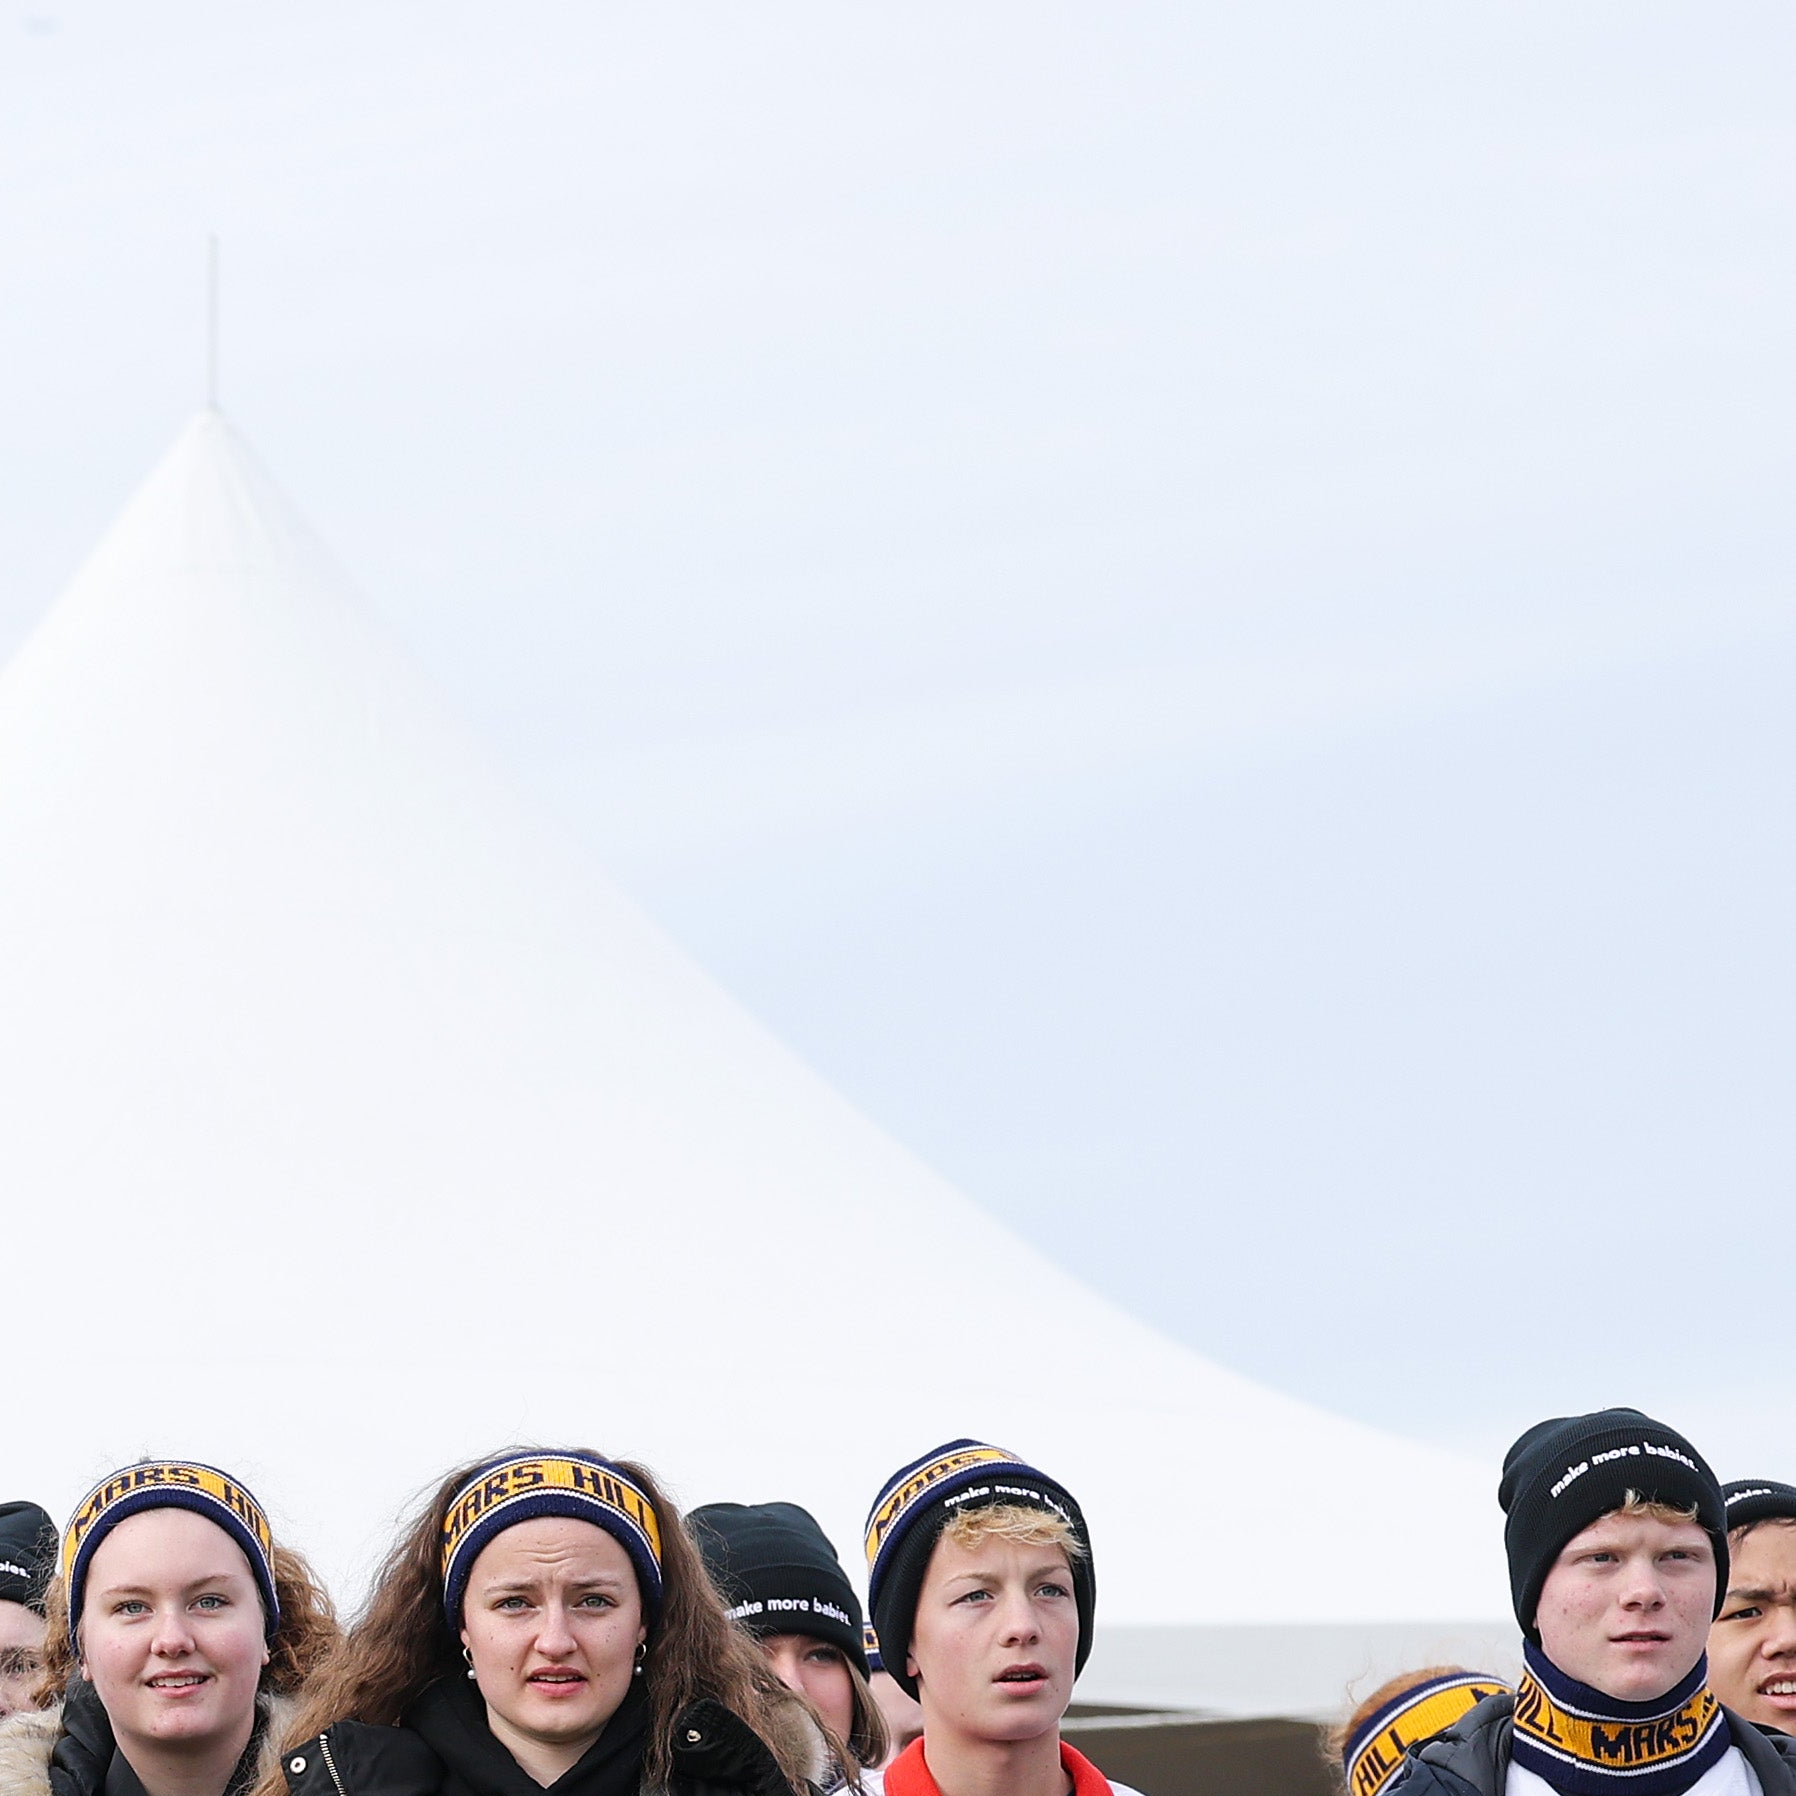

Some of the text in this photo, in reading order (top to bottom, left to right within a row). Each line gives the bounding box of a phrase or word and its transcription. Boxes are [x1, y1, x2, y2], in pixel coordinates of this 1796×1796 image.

[944, 1484, 1040, 1508] make more
[1550, 1441, 1700, 1498] make more babies.
[74, 1465, 200, 1543] MARS
[442, 1463, 651, 1557] MARS HILL
[767, 1597, 809, 1614] more
[1591, 1702, 1699, 1762] MARS
